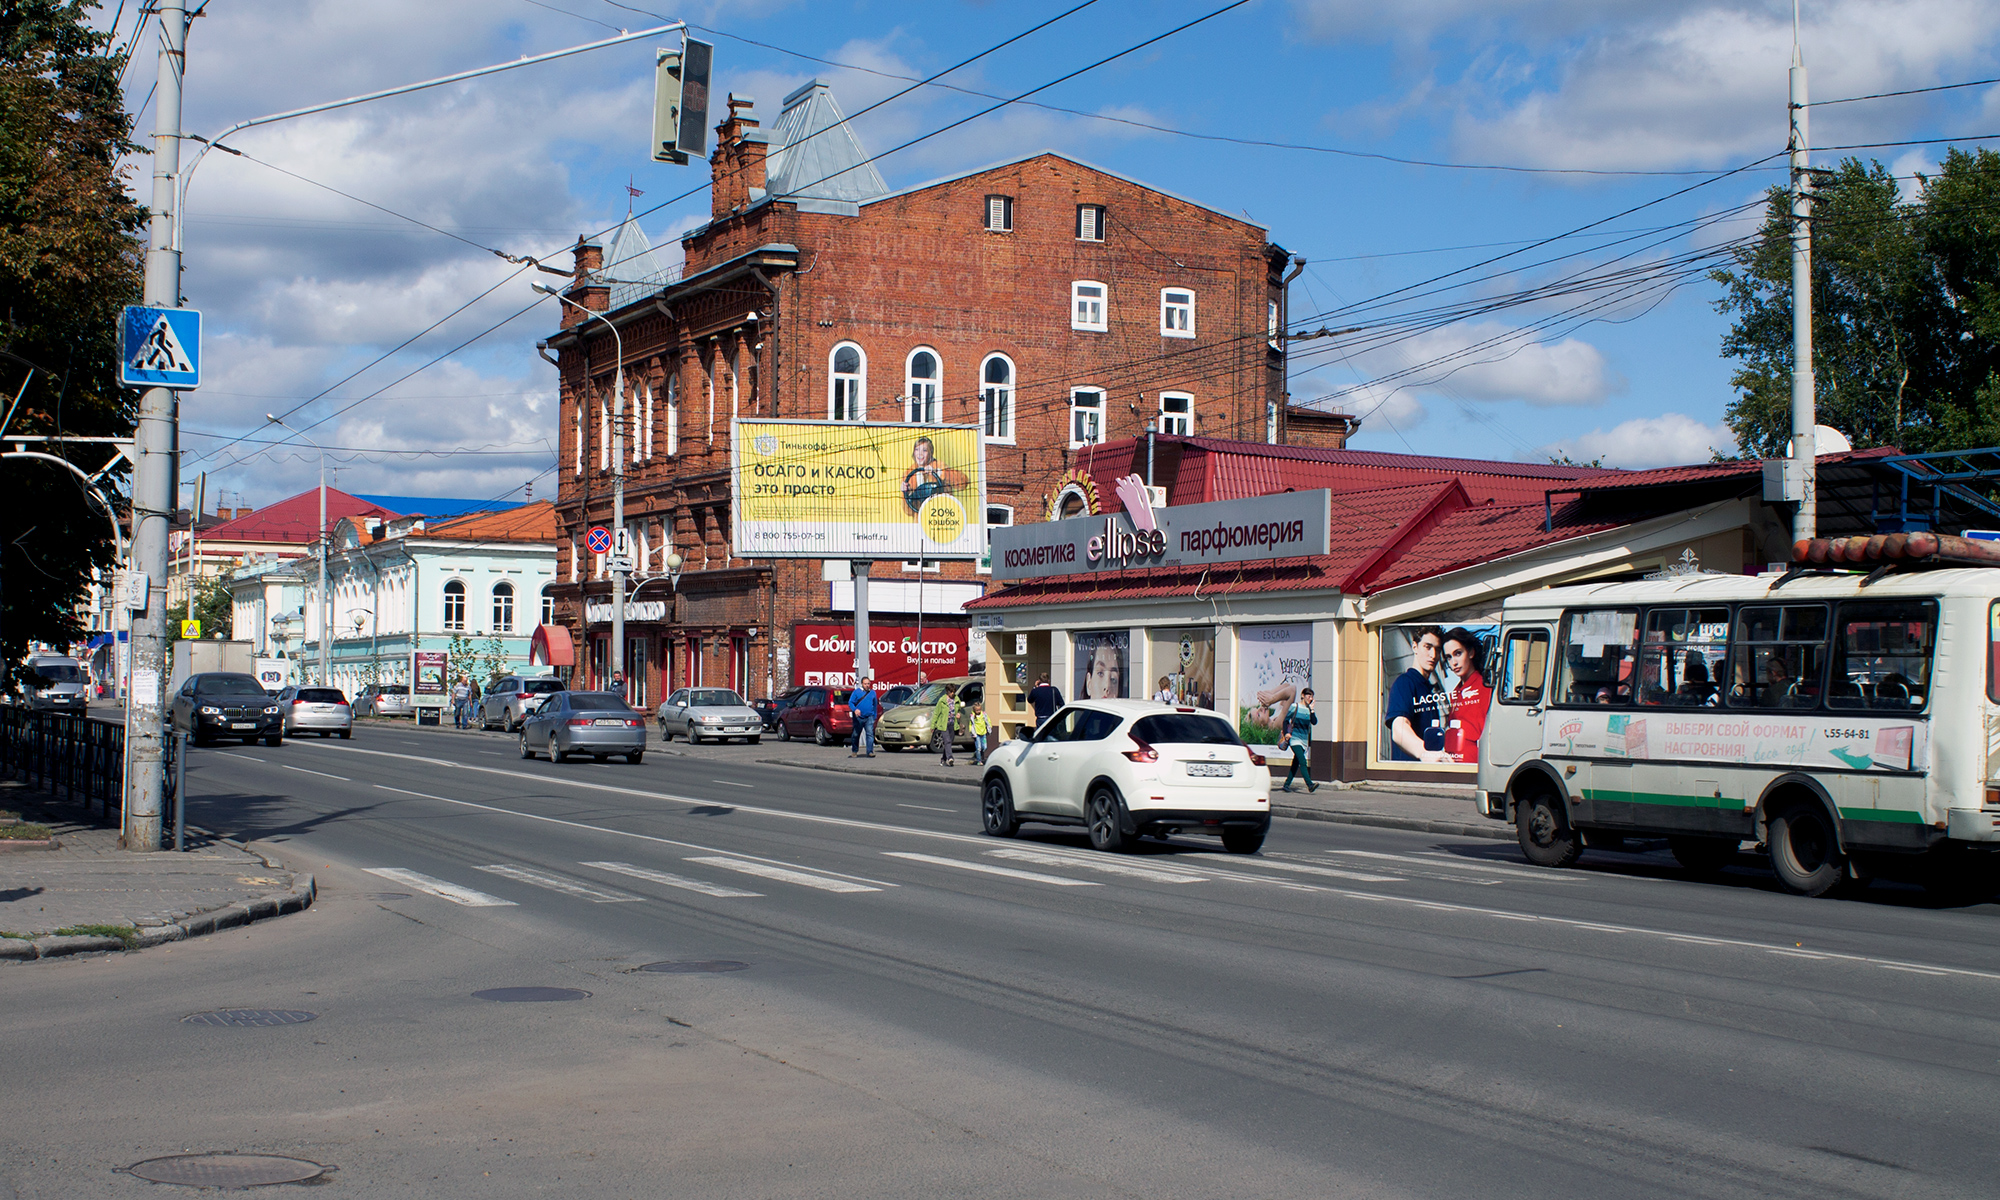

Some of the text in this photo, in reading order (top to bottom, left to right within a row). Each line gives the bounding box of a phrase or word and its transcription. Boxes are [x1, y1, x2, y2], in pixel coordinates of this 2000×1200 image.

[780, 440, 828, 452] Тинькофф
[754, 464, 876, 479] ОСАГО и КАСКО
[754, 483, 836, 497] это просто
[930, 508, 956, 518] 20%
[928, 517, 960, 527] кэшбэк
[852, 532, 889, 541] Tinkoff.ru
[1086, 517, 1167, 567] ellipse
[1180, 519, 1304, 557] парфюмерия
[1004, 542, 1076, 568] косметика
[1109, 632, 1129, 650] SABÓ
[1262, 629, 1291, 640] ESCADA
[930, 657, 956, 665] польза!
[1413, 690, 1458, 706] LACOSTE
[1464, 698, 1480, 706] SPORT
[1665, 720, 1807, 739] ВЫБЕРИ СВОЙ ФОРМАТ
[1830, 728, 1870, 740] 55-64-81
[1664, 741, 1746, 757] НАСТРОЕНИЯ!
